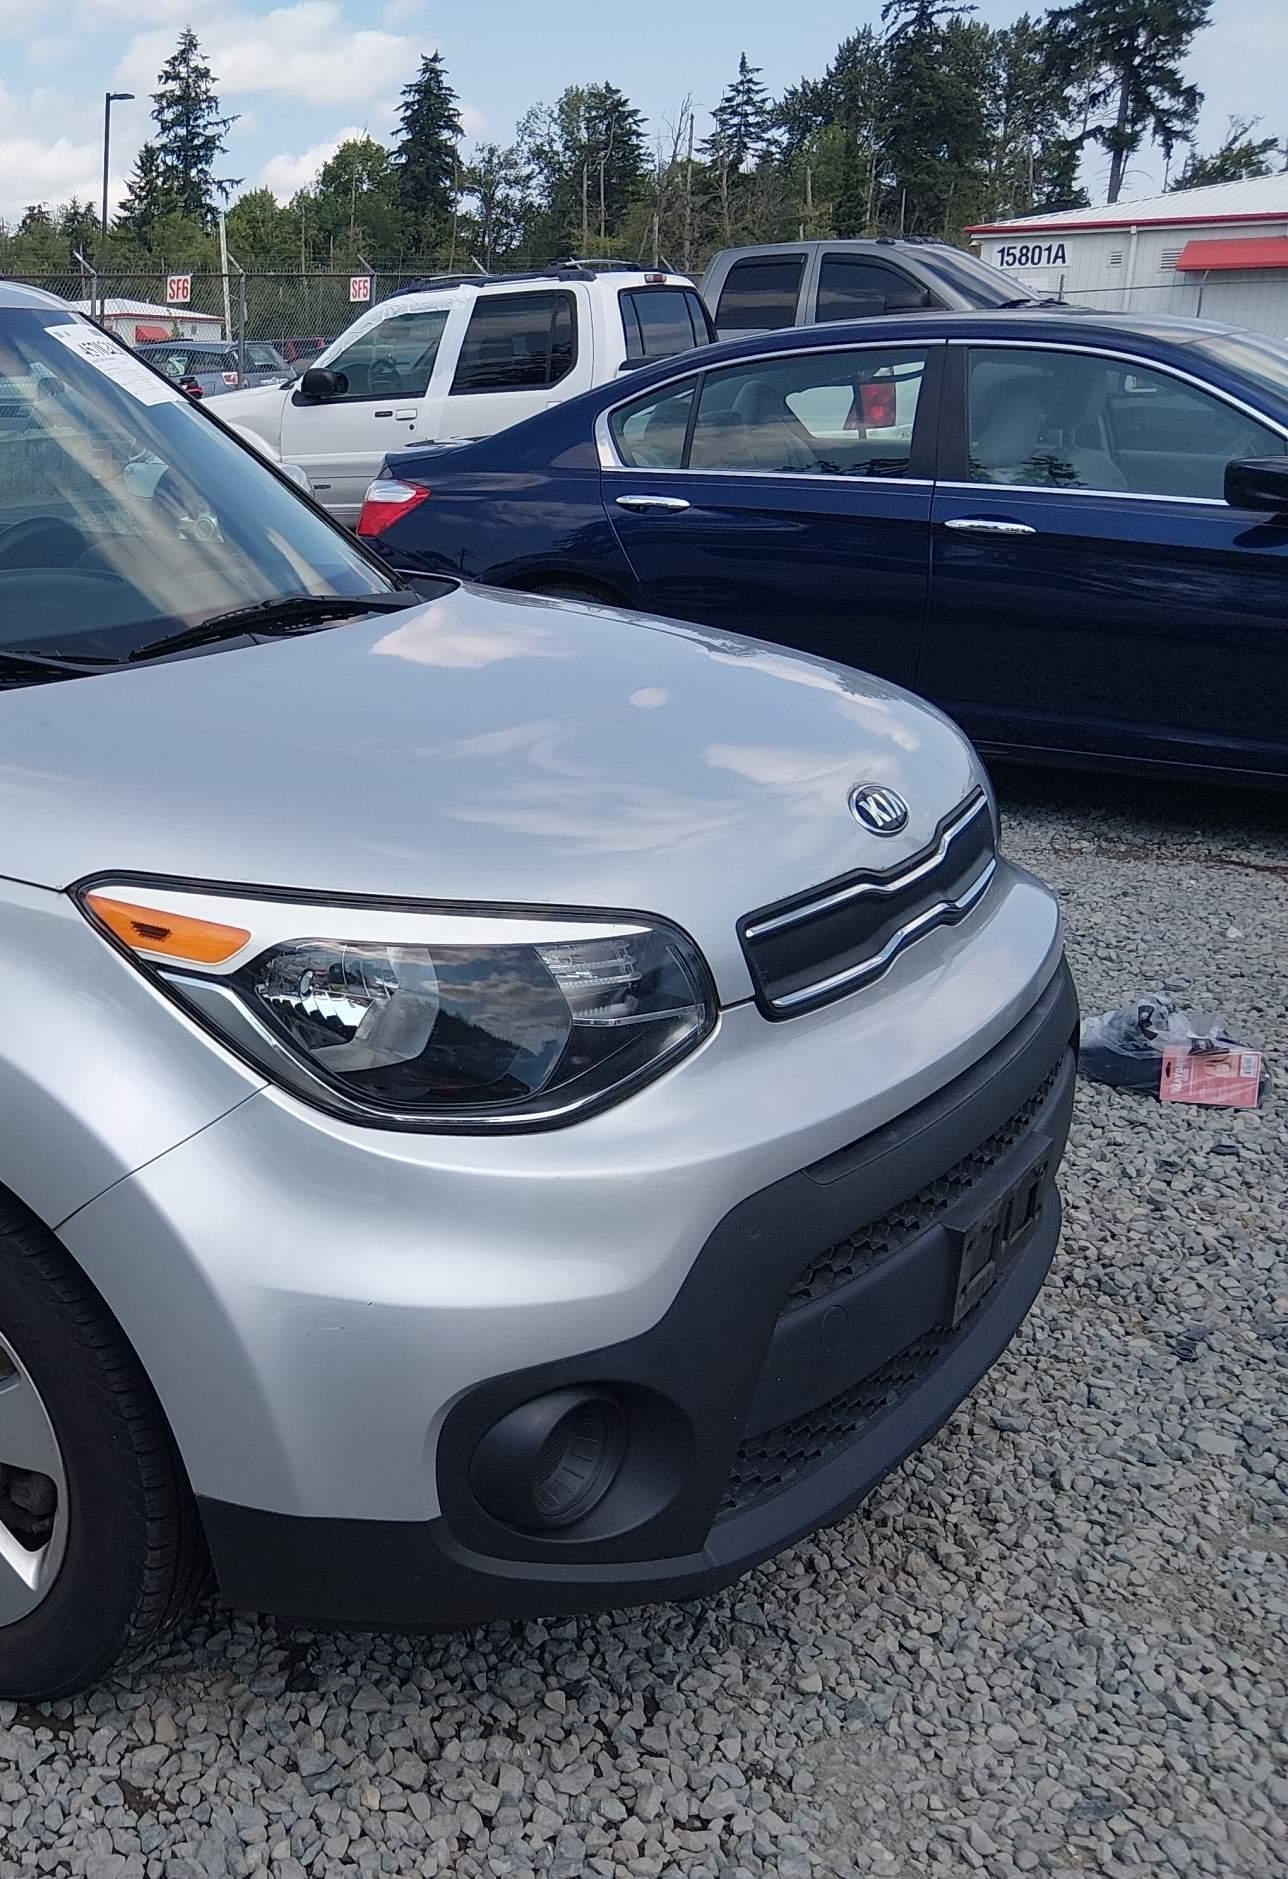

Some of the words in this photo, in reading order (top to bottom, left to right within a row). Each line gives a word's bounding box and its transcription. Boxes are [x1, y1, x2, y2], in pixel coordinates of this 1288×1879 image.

[997, 243, 1066, 267] 15801A
[168, 278, 189, 300] SF6
[351, 279, 369, 299] SF5
[857, 789, 907, 827] KIA
